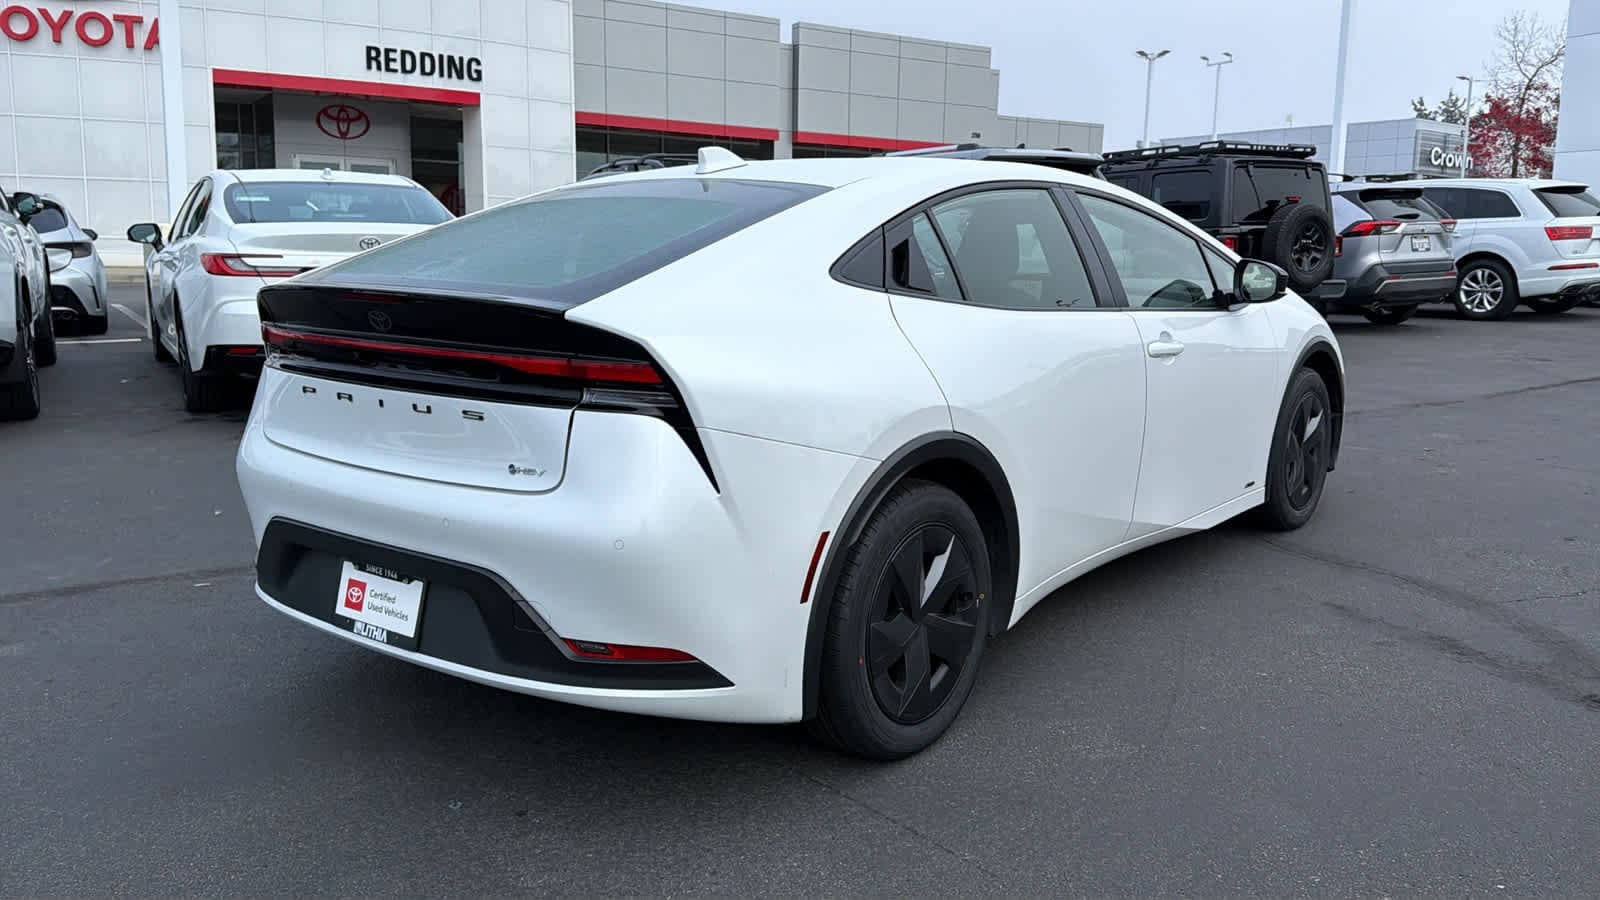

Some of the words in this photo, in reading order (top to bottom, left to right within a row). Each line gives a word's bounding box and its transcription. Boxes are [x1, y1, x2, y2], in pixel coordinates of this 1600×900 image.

[366, 45, 482, 82] REDDING
[1431, 146, 1473, 169] Crown
[302, 385, 485, 421] PRIUS
[366, 563, 383, 575] SINCE
[369, 589, 397, 604] Certified
[367, 601, 383, 613] Used
[384, 607, 409, 622] Vehicles
